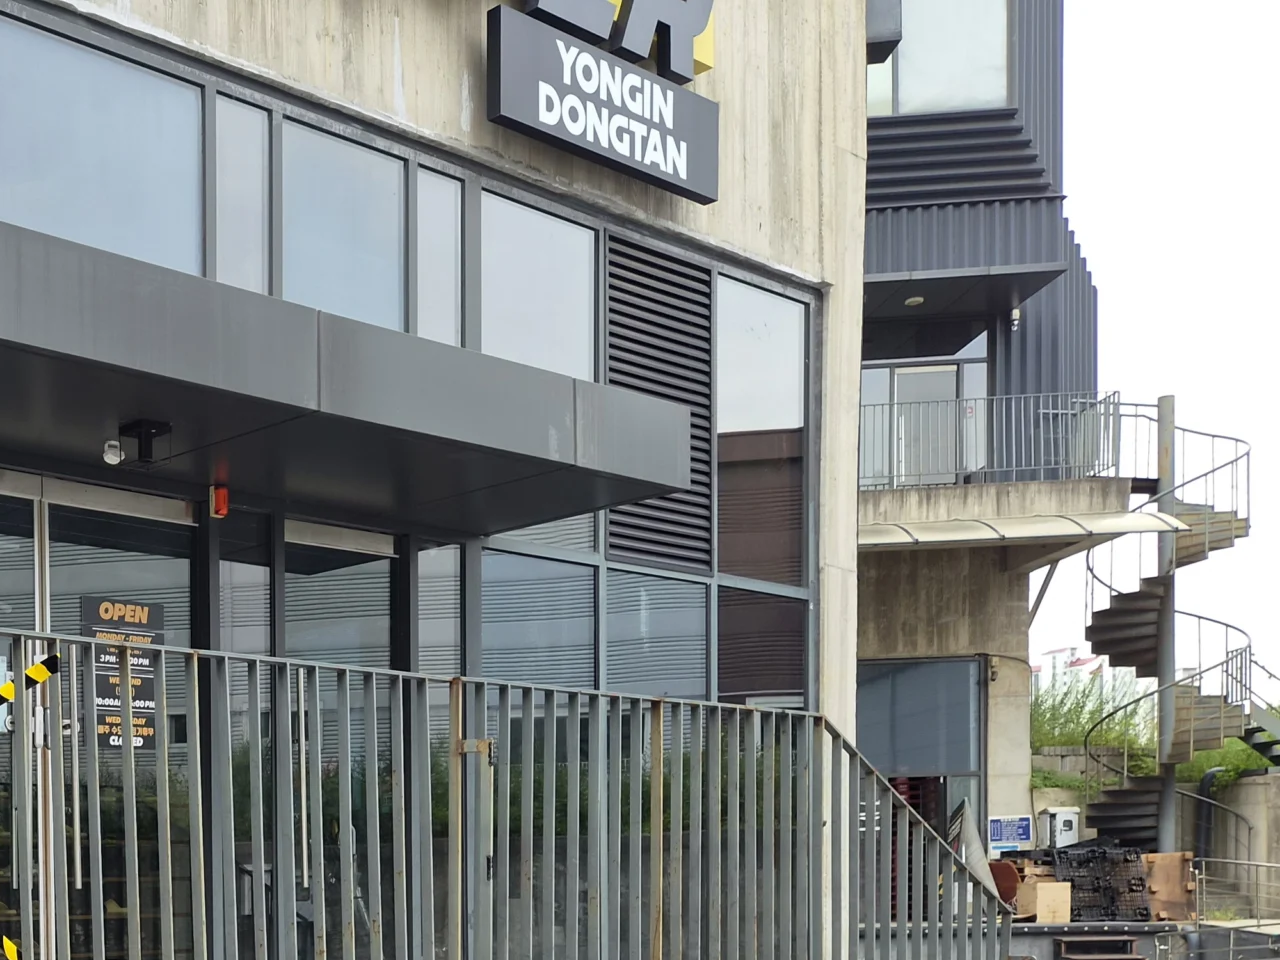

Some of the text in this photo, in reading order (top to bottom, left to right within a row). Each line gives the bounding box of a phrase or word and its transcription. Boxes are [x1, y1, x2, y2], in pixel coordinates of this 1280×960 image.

[555, 38, 674, 130] YONGIN
[538, 80, 688, 181] DONGTAN
[99, 601, 149, 624] OPEN
[96, 632, 126, 643] MONDAY
[129, 635, 152, 644] FRIDAY
[109, 676, 142, 686] WEND
[105, 716, 146, 725] WEDDAY
[109, 735, 143, 747] CLED
